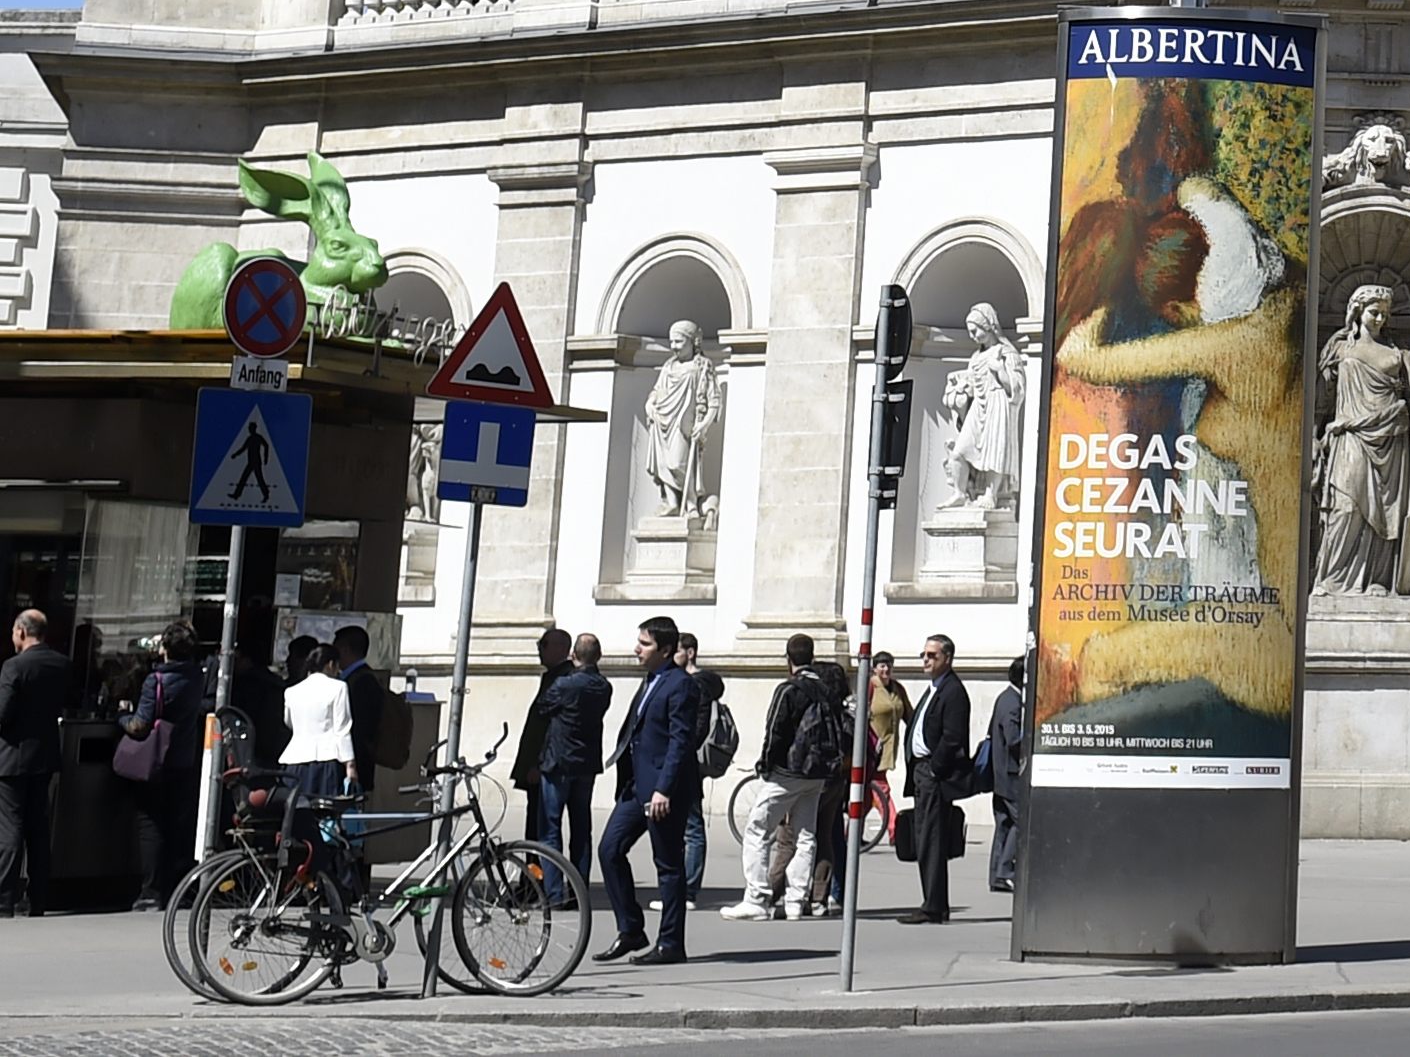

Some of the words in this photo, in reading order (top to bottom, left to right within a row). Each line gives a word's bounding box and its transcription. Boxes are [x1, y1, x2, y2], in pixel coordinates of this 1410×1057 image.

[1078, 28, 1304, 72] ALBERTINA
[238, 363, 282, 389] Anfang
[1059, 433, 1198, 471] DEGAS
[1055, 477, 1248, 517] CEZANNE
[1053, 521, 1208, 559] SEURAT
[1062, 564, 1089, 580] Das
[1052, 583, 1136, 601] ARCHIV
[1140, 584, 1184, 602] DER
[1189, 581, 1280, 605] TRÄUME
[1059, 610, 1084, 621] aus
[1088, 607, 1121, 622] dem
[1127, 604, 1190, 623] Musée
[1041, 736, 1071, 747] TÄGLICH
[1072, 737, 1081, 747] 10
[1082, 737, 1095, 747] BIS
[1126, 738, 1170, 749] MITTWOCH
[1171, 739, 1185, 749] BIS
[1186, 739, 1196, 749] 21
[1197, 739, 1214, 750] UHR
